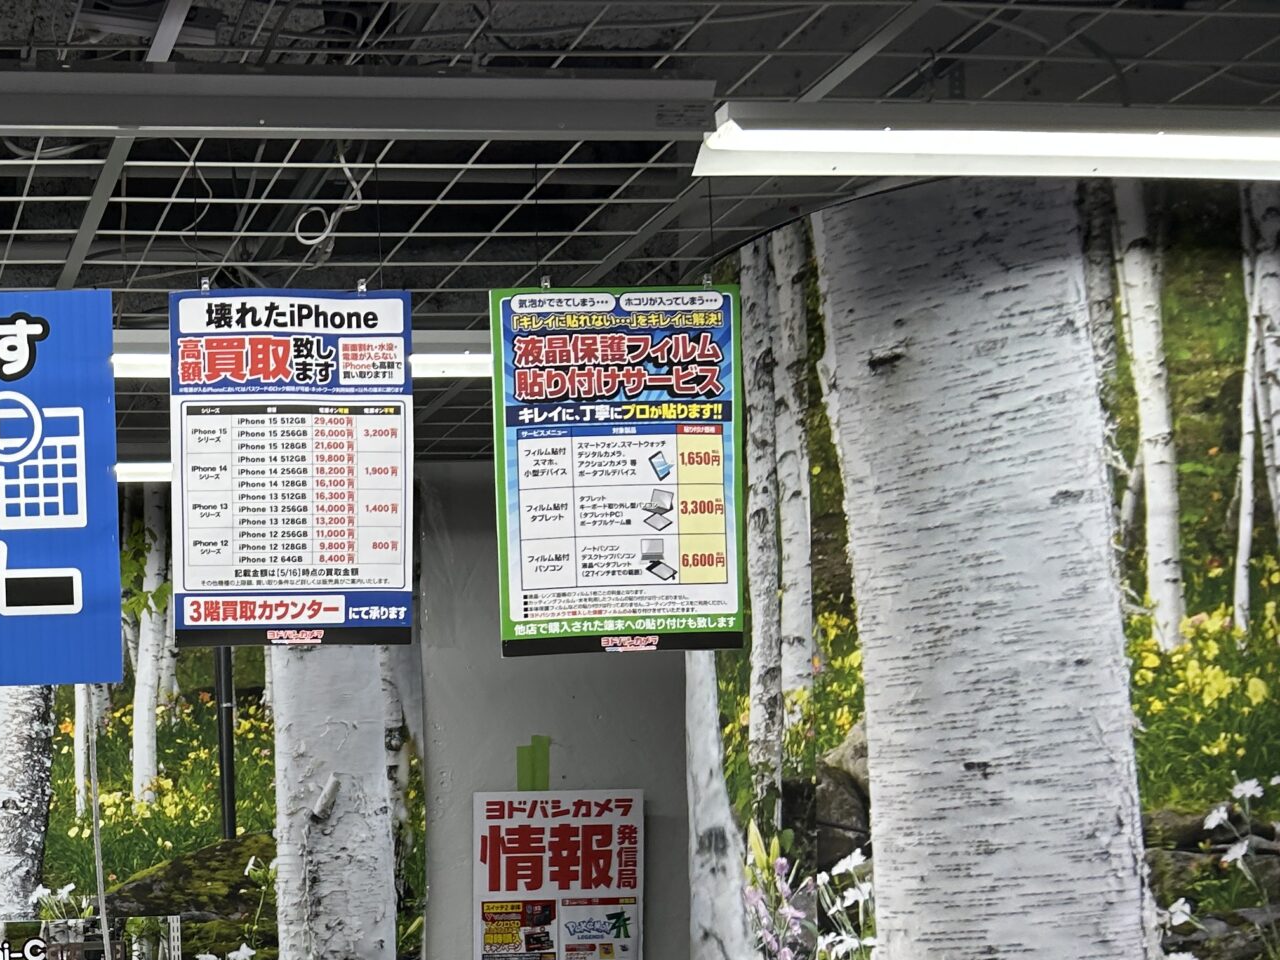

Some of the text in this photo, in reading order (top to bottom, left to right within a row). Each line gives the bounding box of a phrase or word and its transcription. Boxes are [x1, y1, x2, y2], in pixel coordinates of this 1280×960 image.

[206, 302, 378, 329] 壊れたiPhone
[514, 333, 722, 367] 液晶保護フィルム
[204, 335, 293, 384] 買取
[515, 365, 722, 400] 貼り付けサービス
[524, 448, 566, 456] フィルム貼付
[524, 468, 567, 477] 小型デバイス
[526, 503, 568, 512] フィルム貼付
[530, 514, 564, 522] タブレット
[239, 530, 308, 538] iPhone 12 256GB
[239, 543, 307, 551] iPhone 12 128GB
[239, 556, 303, 564] iPhone 12 64GB
[527, 554, 570, 562] フィルム貼付
[534, 564, 563, 572] パソコン
[190, 600, 339, 622] 3階買取カウンター
[349, 606, 407, 620] にて承ります
[514, 616, 736, 636] 他店で購入された端末への貼り付けも致します
[485, 798, 633, 820] ヨドバシカメラ
[480, 824, 614, 892] 情報
[616, 824, 638, 890] 発信局
